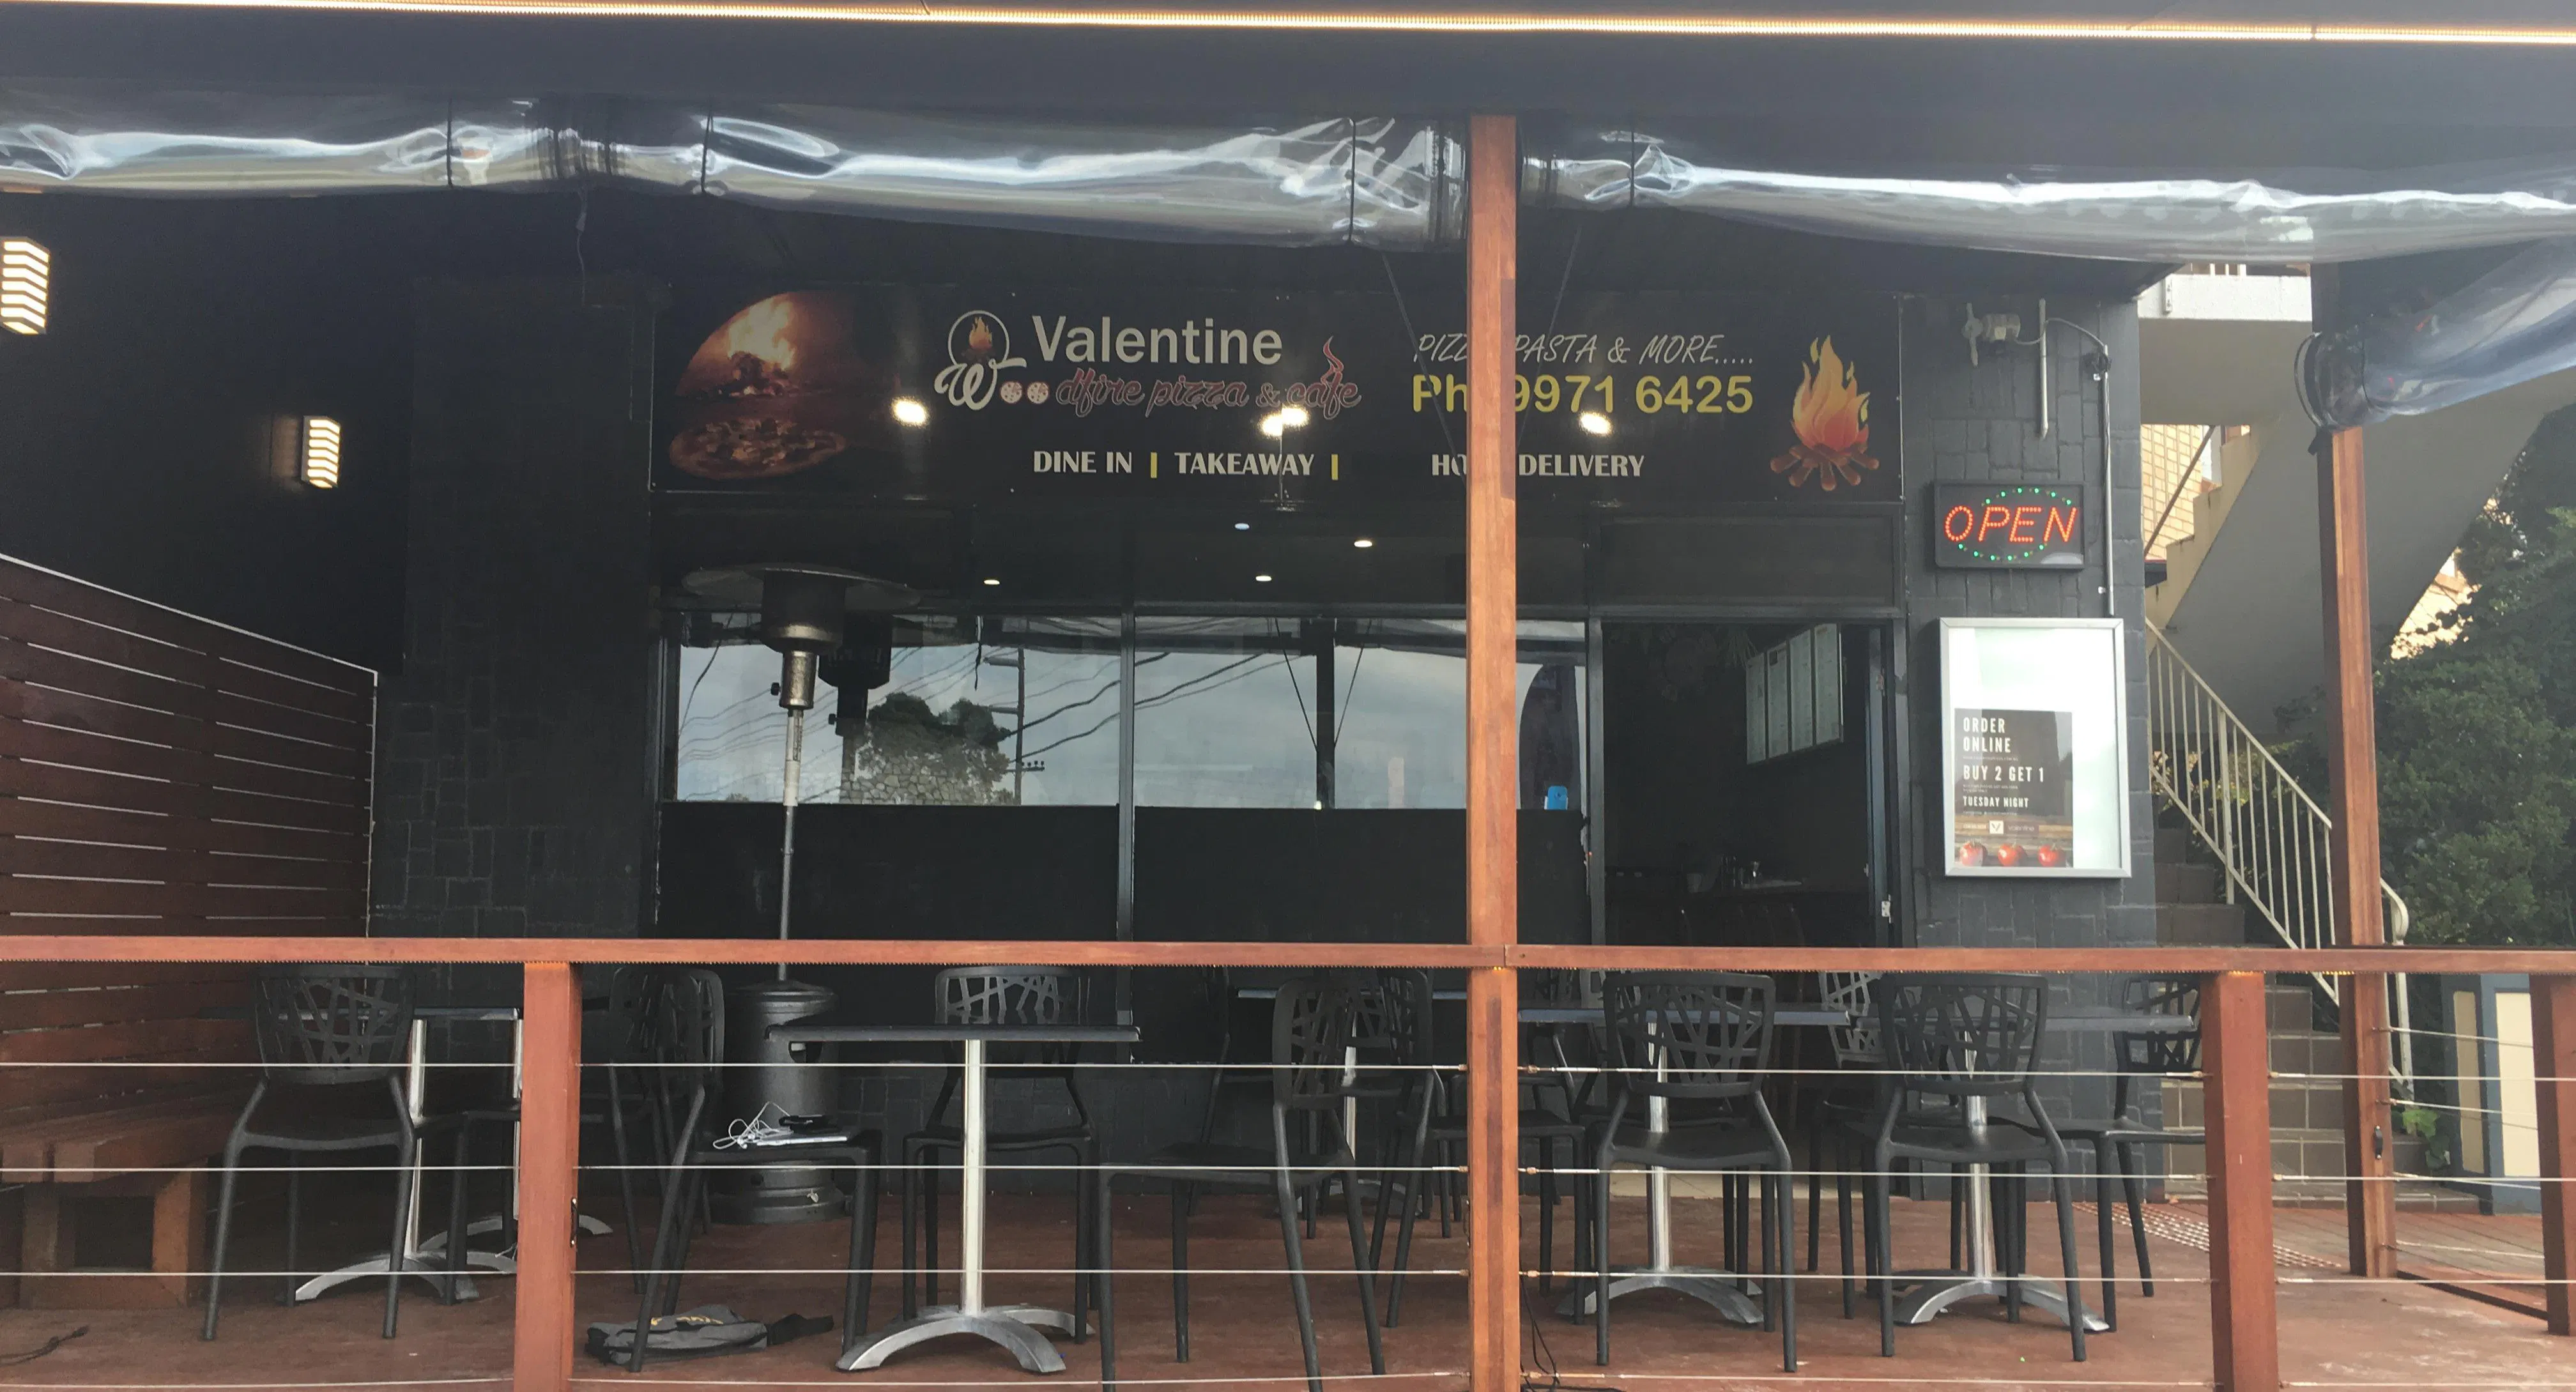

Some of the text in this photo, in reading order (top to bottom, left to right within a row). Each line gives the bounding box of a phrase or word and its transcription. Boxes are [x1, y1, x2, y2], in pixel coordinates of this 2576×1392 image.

[1032, 315, 1282, 365] Valentine
[1413, 333, 1468, 363] PIZZ
[1515, 334, 1597, 363] PASTA
[1607, 337, 1630, 363] &
[1145, 374, 1250, 418] pizza
[1255, 382, 1281, 408] &
[1286, 359, 1362, 420] cafe
[1515, 374, 1613, 413] 9971
[1636, 375, 1754, 413] 6425
[1034, 450, 1315, 476] DINE IN TAKEAWAY
[1519, 454, 1644, 477] DELIVERY
[1944, 505, 2078, 542] OPEN
[1963, 717, 2005, 734] ORDER
[1963, 736, 2011, 753] ONLINE
[1963, 765, 2044, 783] BUY 2 GET 1
[1963, 795, 2029, 808] TUESDAY NIGHT
